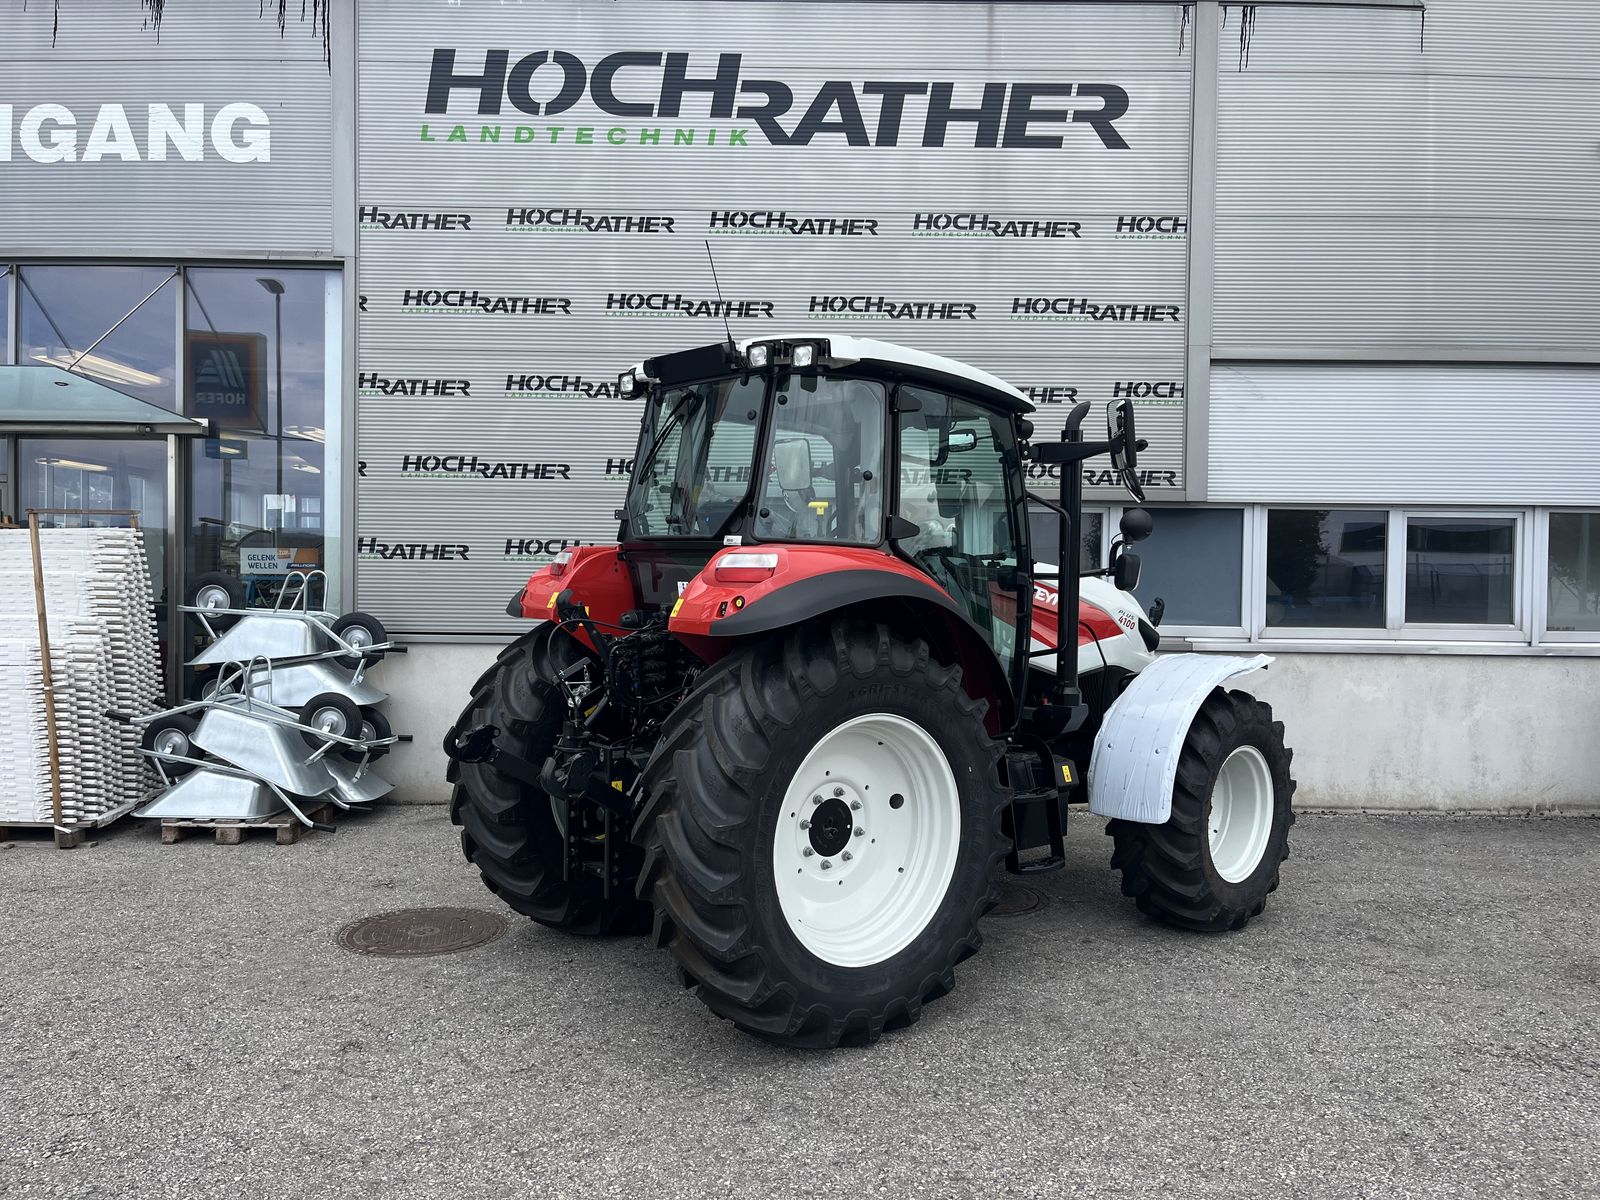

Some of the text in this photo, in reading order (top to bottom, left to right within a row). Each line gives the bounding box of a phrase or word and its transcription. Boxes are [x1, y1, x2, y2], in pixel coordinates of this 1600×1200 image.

[424, 48, 1131, 149] HOCHRATHER
[0, 102, 271, 163] GANG
[420, 124, 749, 146] LANDTECHNIK
[505, 208, 675, 233] HOCHRATHER
[709, 211, 879, 236] HOCHRATHER
[913, 213, 1082, 239] HOCHRATHER
[402, 289, 572, 315] HOCHRATHER
[605, 293, 775, 319] HOCHRATHER
[808, 296, 977, 320] HOCHRATHER
[1011, 297, 1181, 322] HOCHRATHER
[402, 455, 571, 480] HOCHRATHER
[1118, 609, 1136, 620] PLUS
[1118, 615, 1136, 630] 4100
